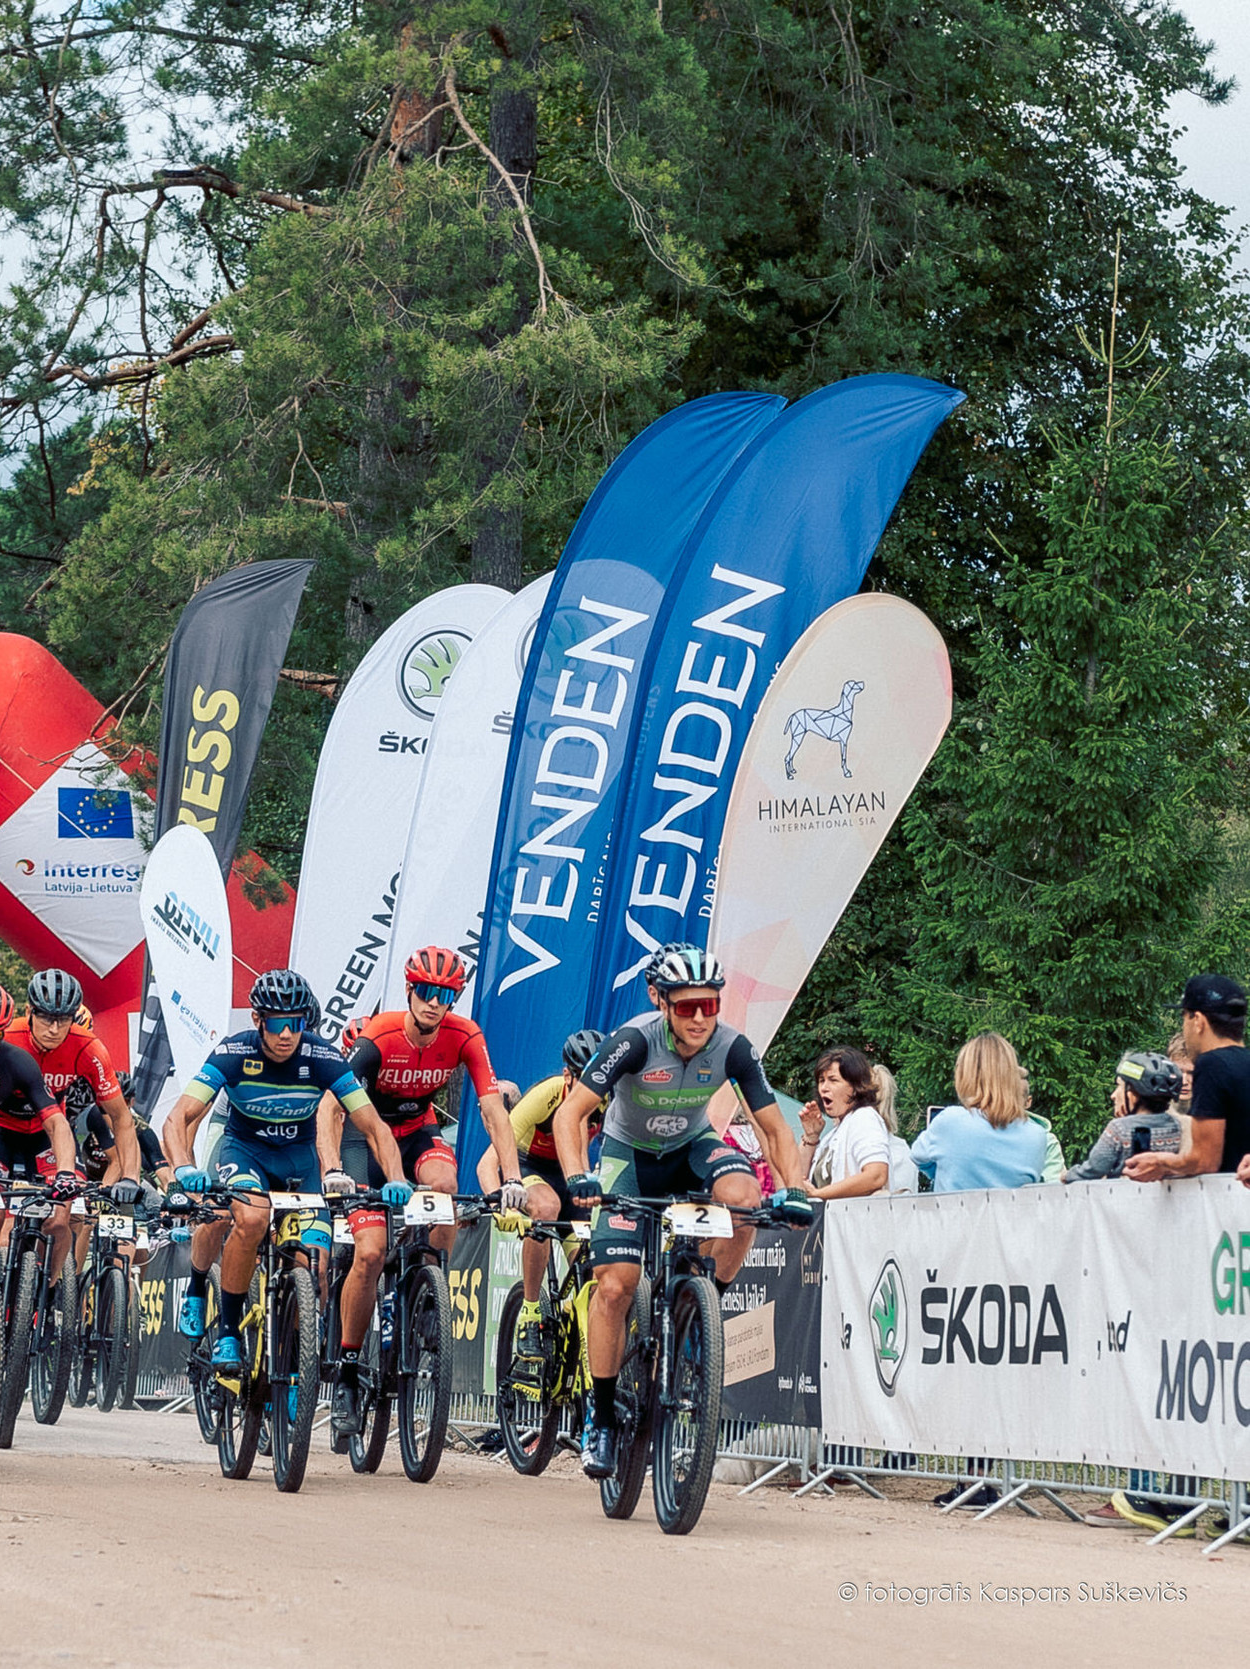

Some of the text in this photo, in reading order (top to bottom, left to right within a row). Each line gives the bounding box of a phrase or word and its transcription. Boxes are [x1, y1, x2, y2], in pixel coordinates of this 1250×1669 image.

[612, 563, 787, 992] VENDEN
[498, 595, 650, 997] VENDEN
[758, 791, 886, 822] HIMALAYAN
[769, 817, 877, 834] INTERNATIONAL SIA
[44, 859, 141, 882] Interreg
[317, 931, 387, 1045] GREEN
[600, 1041, 631, 1074] Dobele
[658, 1094, 710, 1106] Dobele
[422, 1194, 436, 1213] 5
[694, 1207, 710, 1224] 2
[106, 1217, 126, 1231] 33
[766, 1238, 786, 1277] māja
[920, 1268, 1069, 1366] ŠKODA
